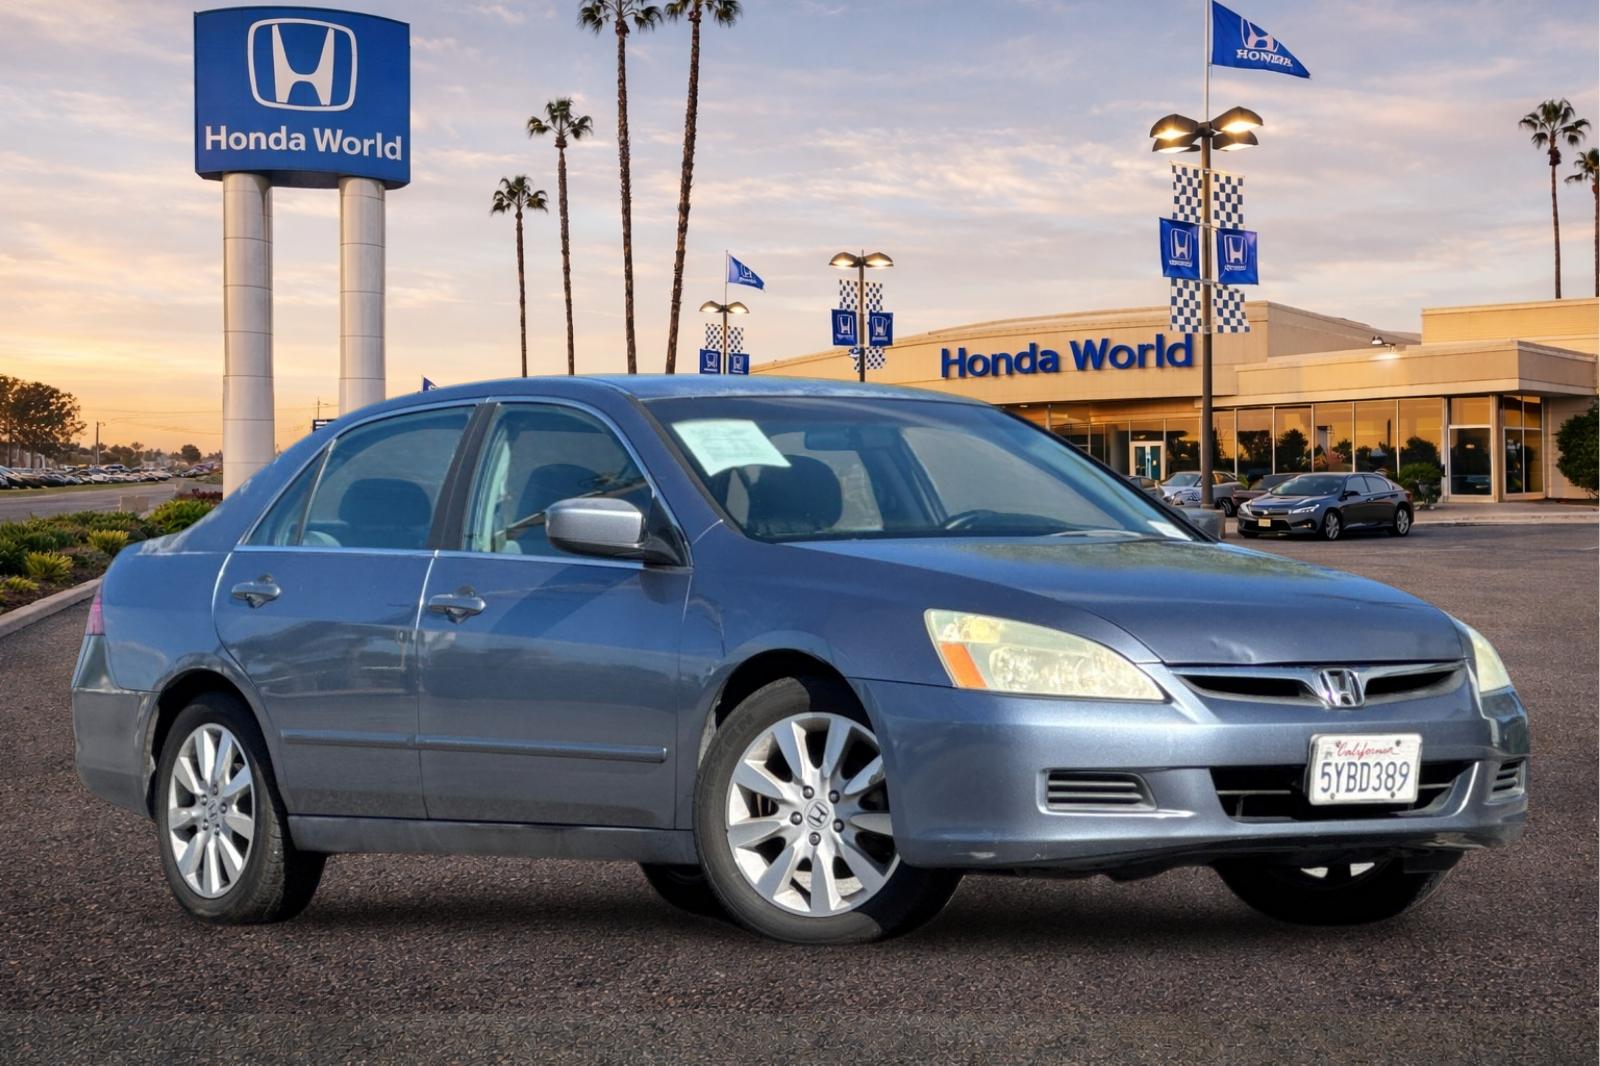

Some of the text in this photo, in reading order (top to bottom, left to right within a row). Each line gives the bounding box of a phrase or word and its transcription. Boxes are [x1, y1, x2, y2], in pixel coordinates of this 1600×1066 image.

[205, 125, 402, 161] Honda World
[940, 333, 1194, 379] Honda World
[1320, 761, 1410, 793] 5YBD389
